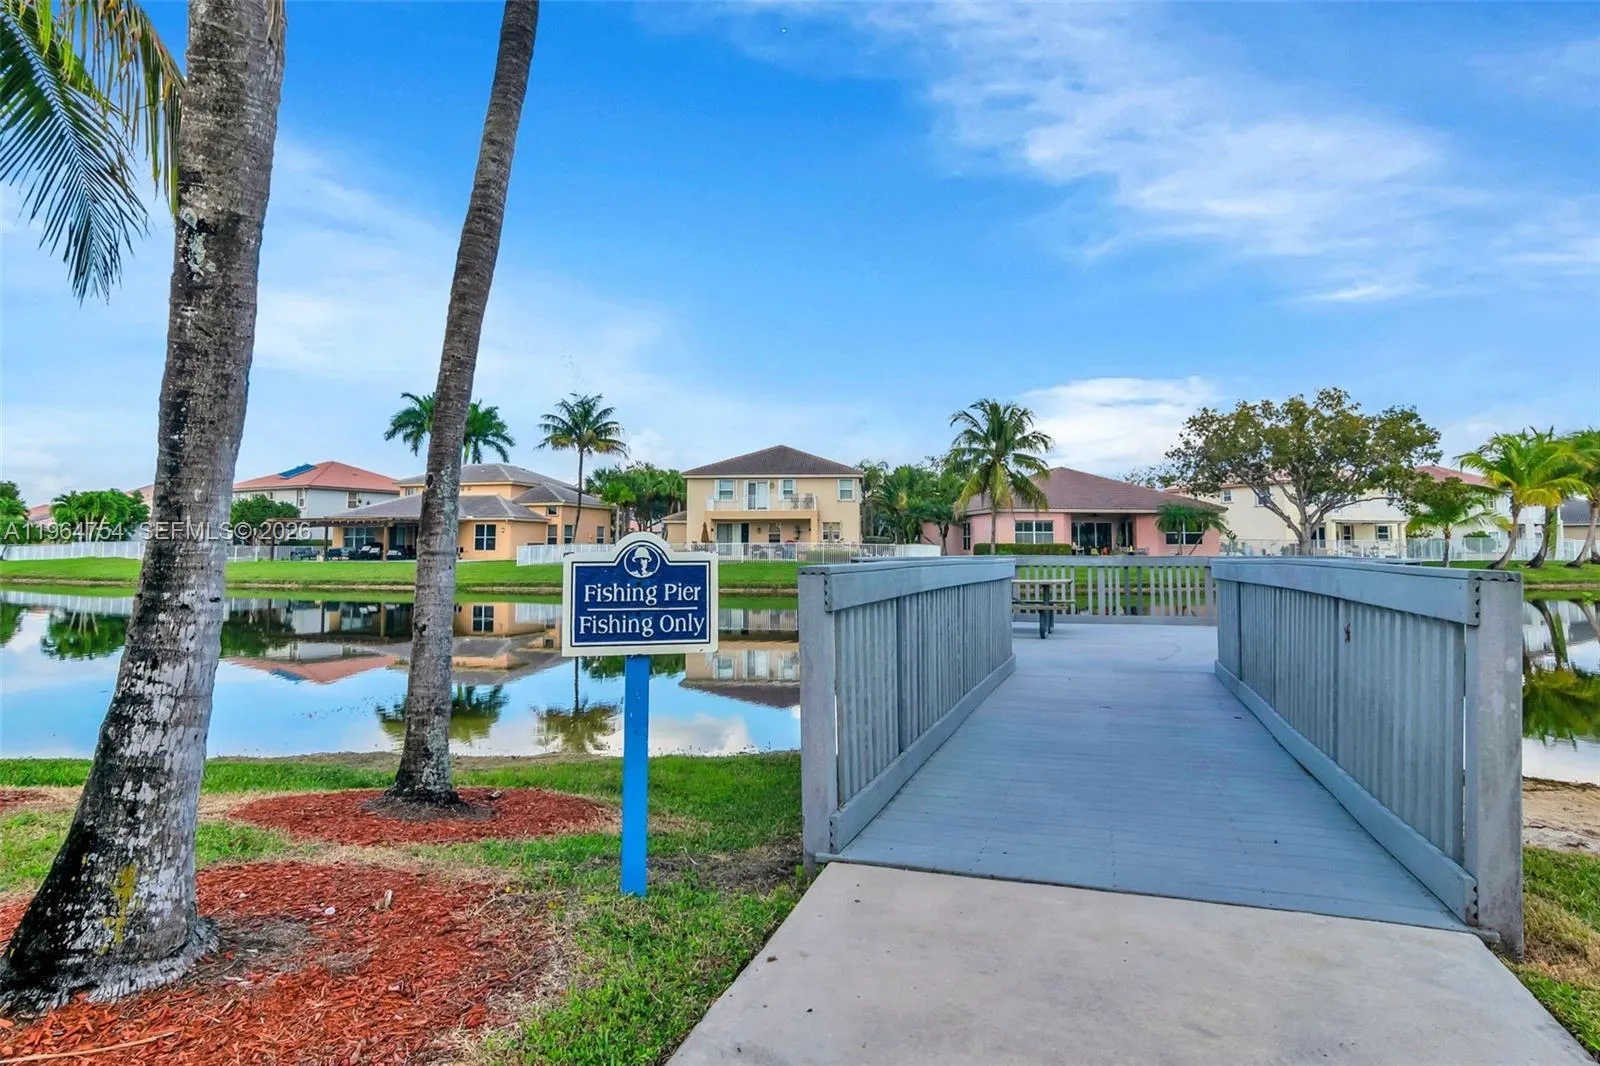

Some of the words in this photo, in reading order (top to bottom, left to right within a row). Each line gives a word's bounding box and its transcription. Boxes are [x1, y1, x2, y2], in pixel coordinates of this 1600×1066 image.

[584, 583, 657, 606] Fishing
[664, 583, 701, 602] Pier
[579, 615, 654, 637] Fishing
[659, 613, 705, 636] Only
